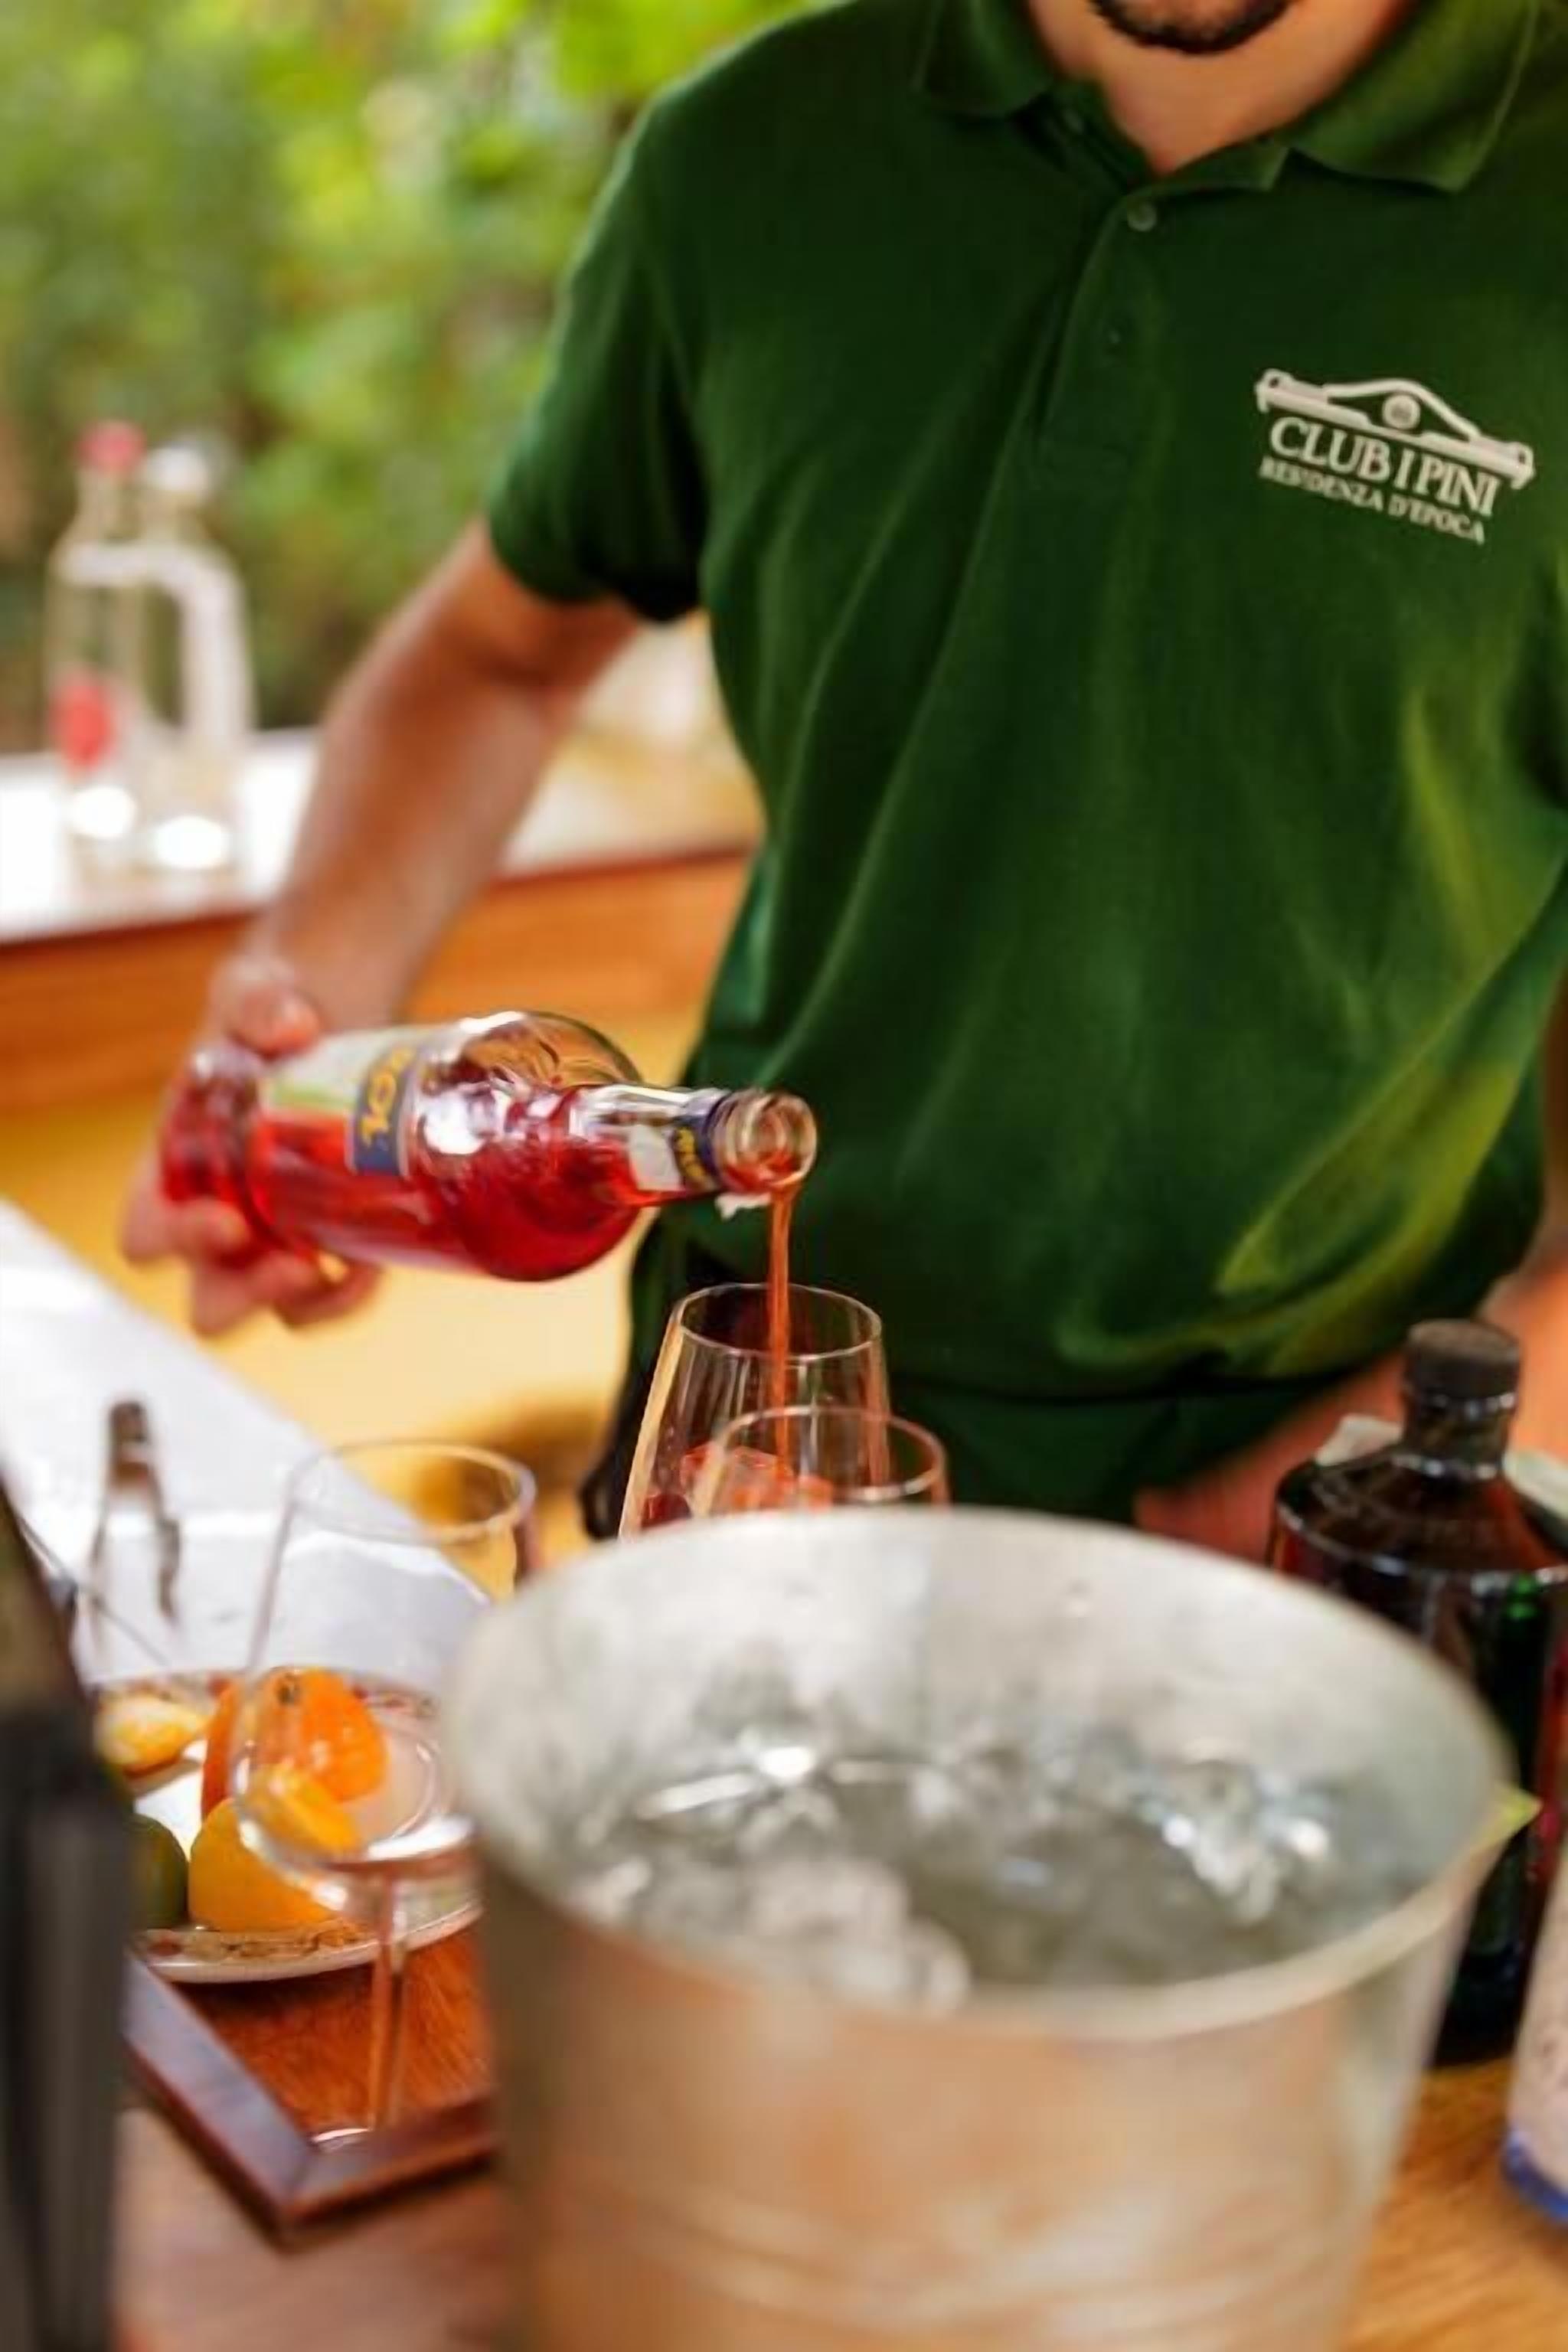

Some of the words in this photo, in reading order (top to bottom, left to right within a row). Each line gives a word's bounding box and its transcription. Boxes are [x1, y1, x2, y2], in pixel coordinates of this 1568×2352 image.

[1269, 416, 1391, 482] CLUB
[1393, 448, 1416, 489] I
[1413, 453, 1501, 518] PINI
